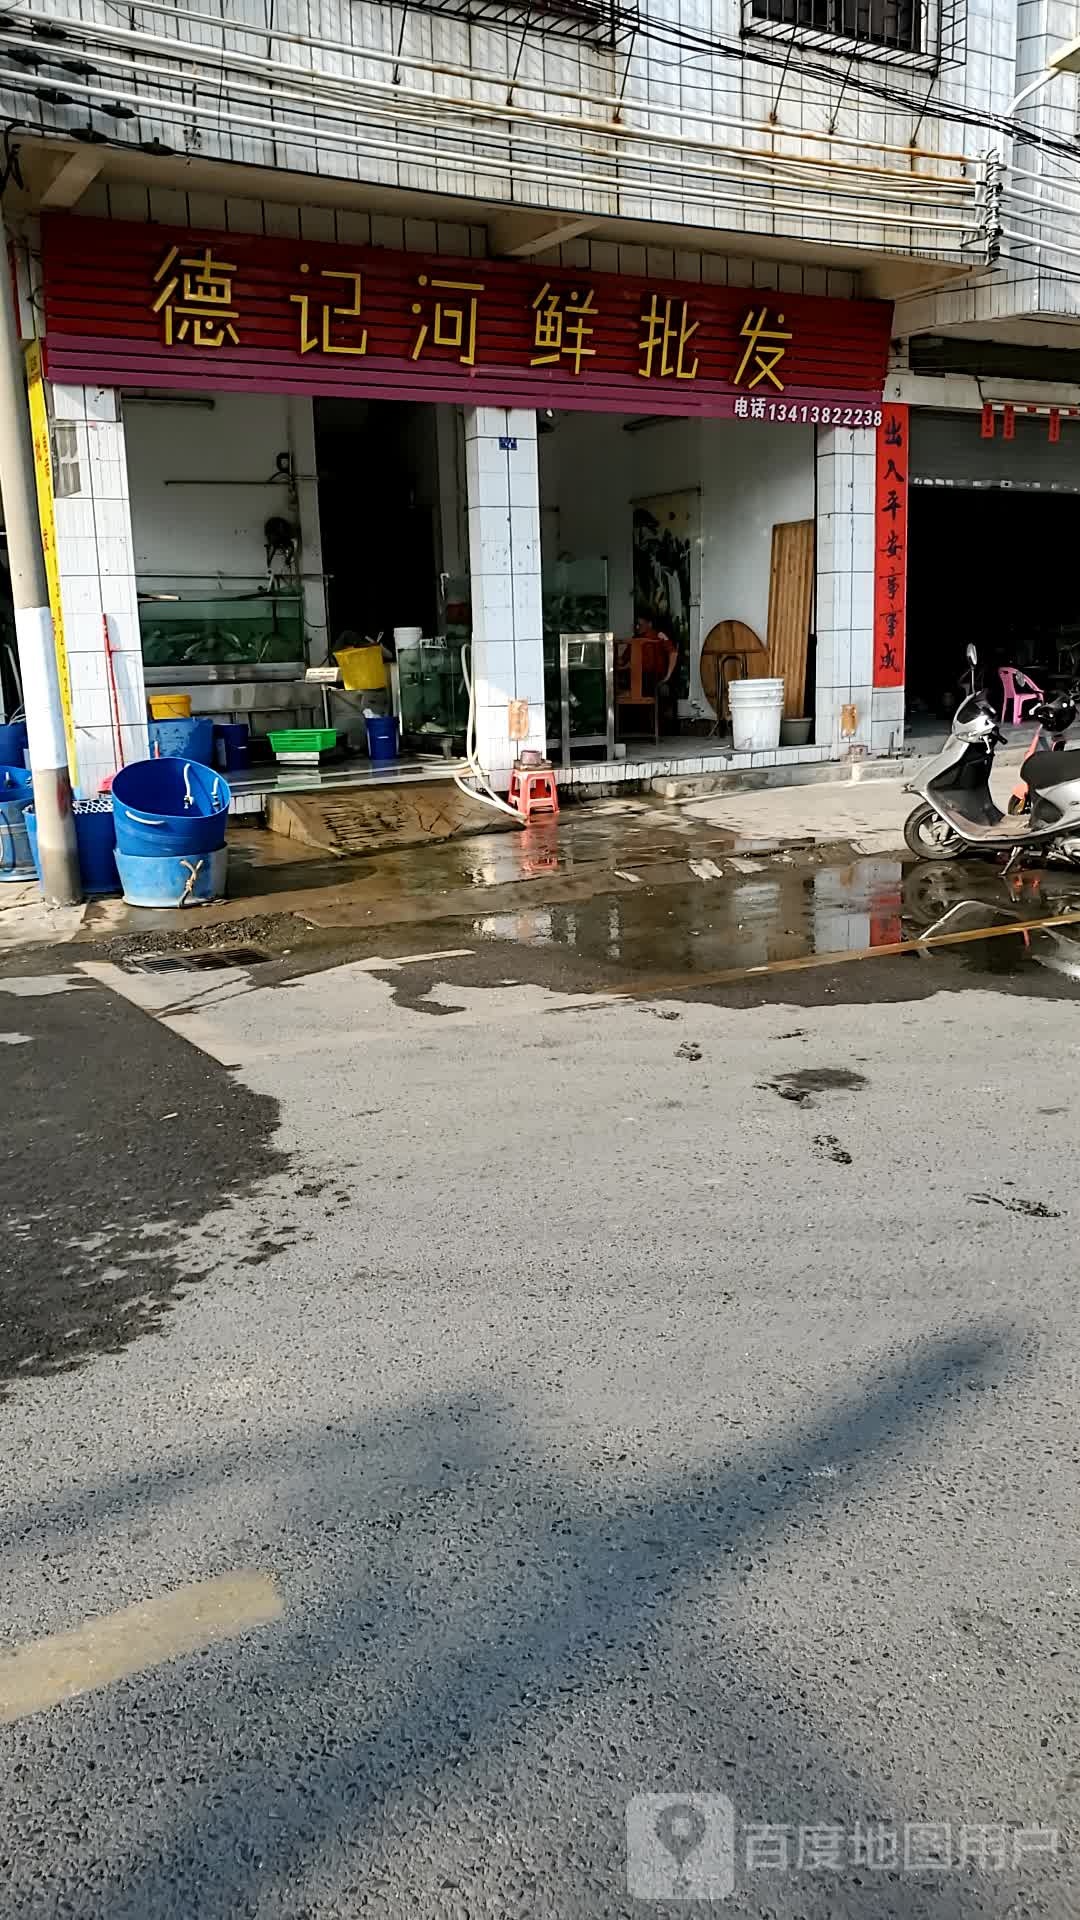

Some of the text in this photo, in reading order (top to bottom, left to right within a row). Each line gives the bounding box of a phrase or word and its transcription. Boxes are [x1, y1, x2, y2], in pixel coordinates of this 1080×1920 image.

[153, 245, 794, 392] 德记河鲜批发
